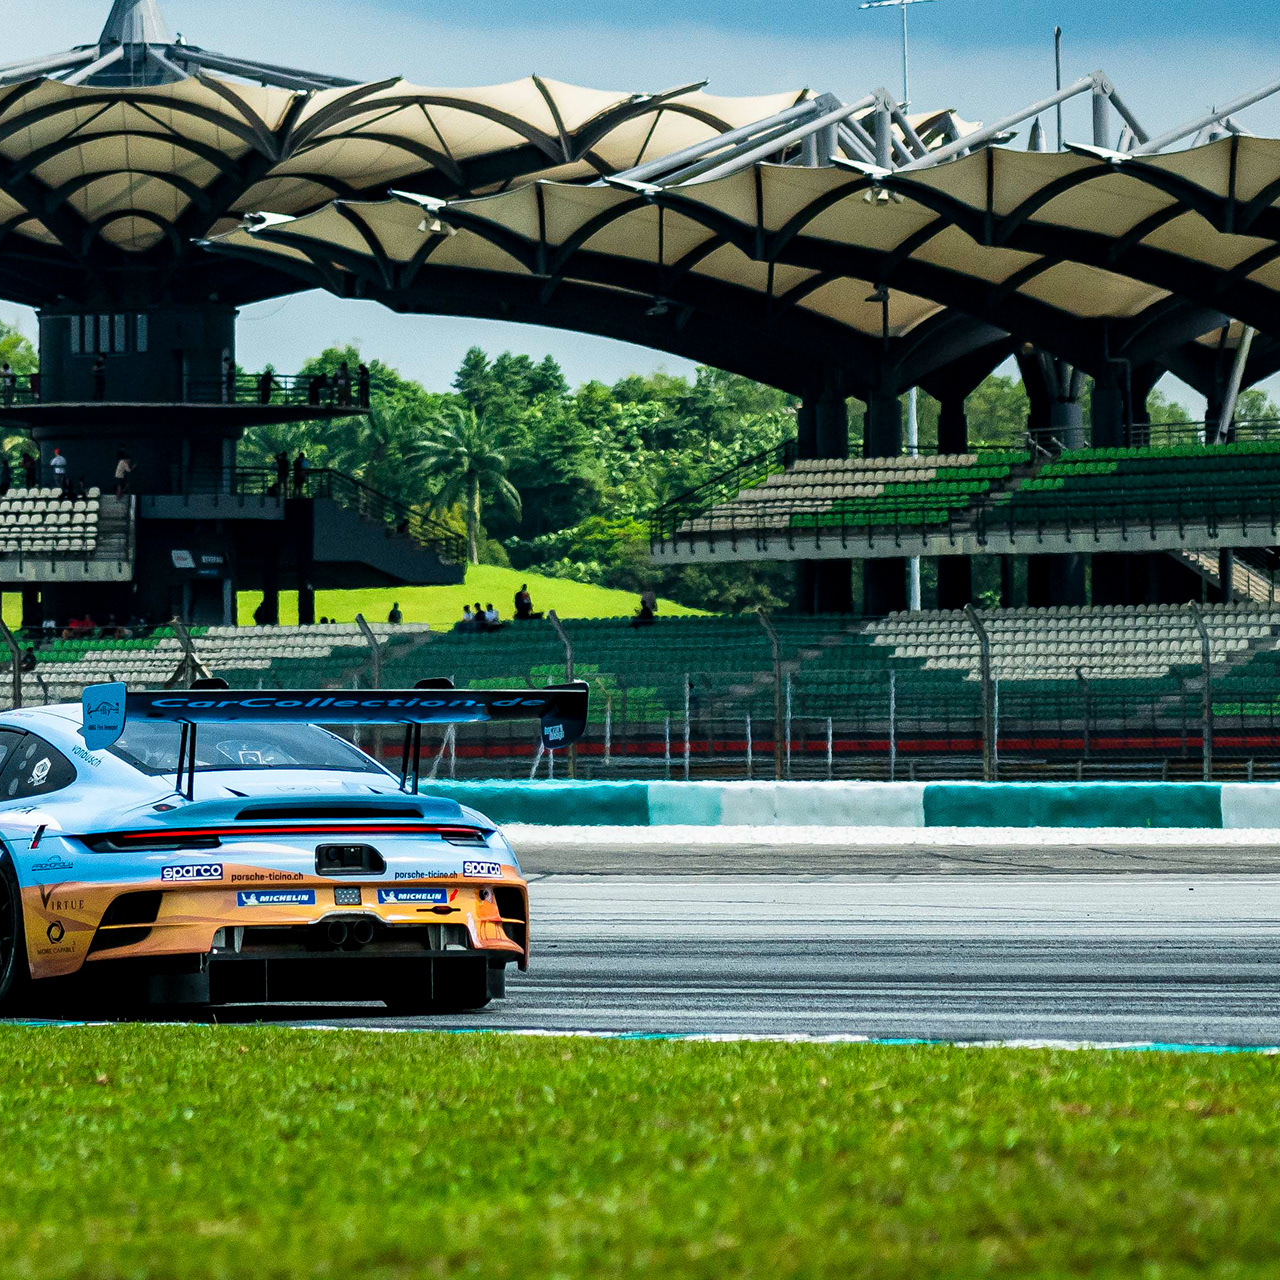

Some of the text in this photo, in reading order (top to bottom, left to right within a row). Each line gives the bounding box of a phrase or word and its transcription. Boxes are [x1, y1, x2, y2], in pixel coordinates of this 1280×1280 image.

[151, 697, 546, 708] CarCollection.de
[163, 864, 222, 880] sparco
[464, 862, 501, 876] sparco
[231, 872, 304, 882] porsche-ticino.ch
[394, 870, 458, 881] porsche-ticino.ch
[33, 879, 85, 911] VIRTUE
[259, 894, 309, 902] MICHELIN
[398, 892, 442, 900] MICHELIN
